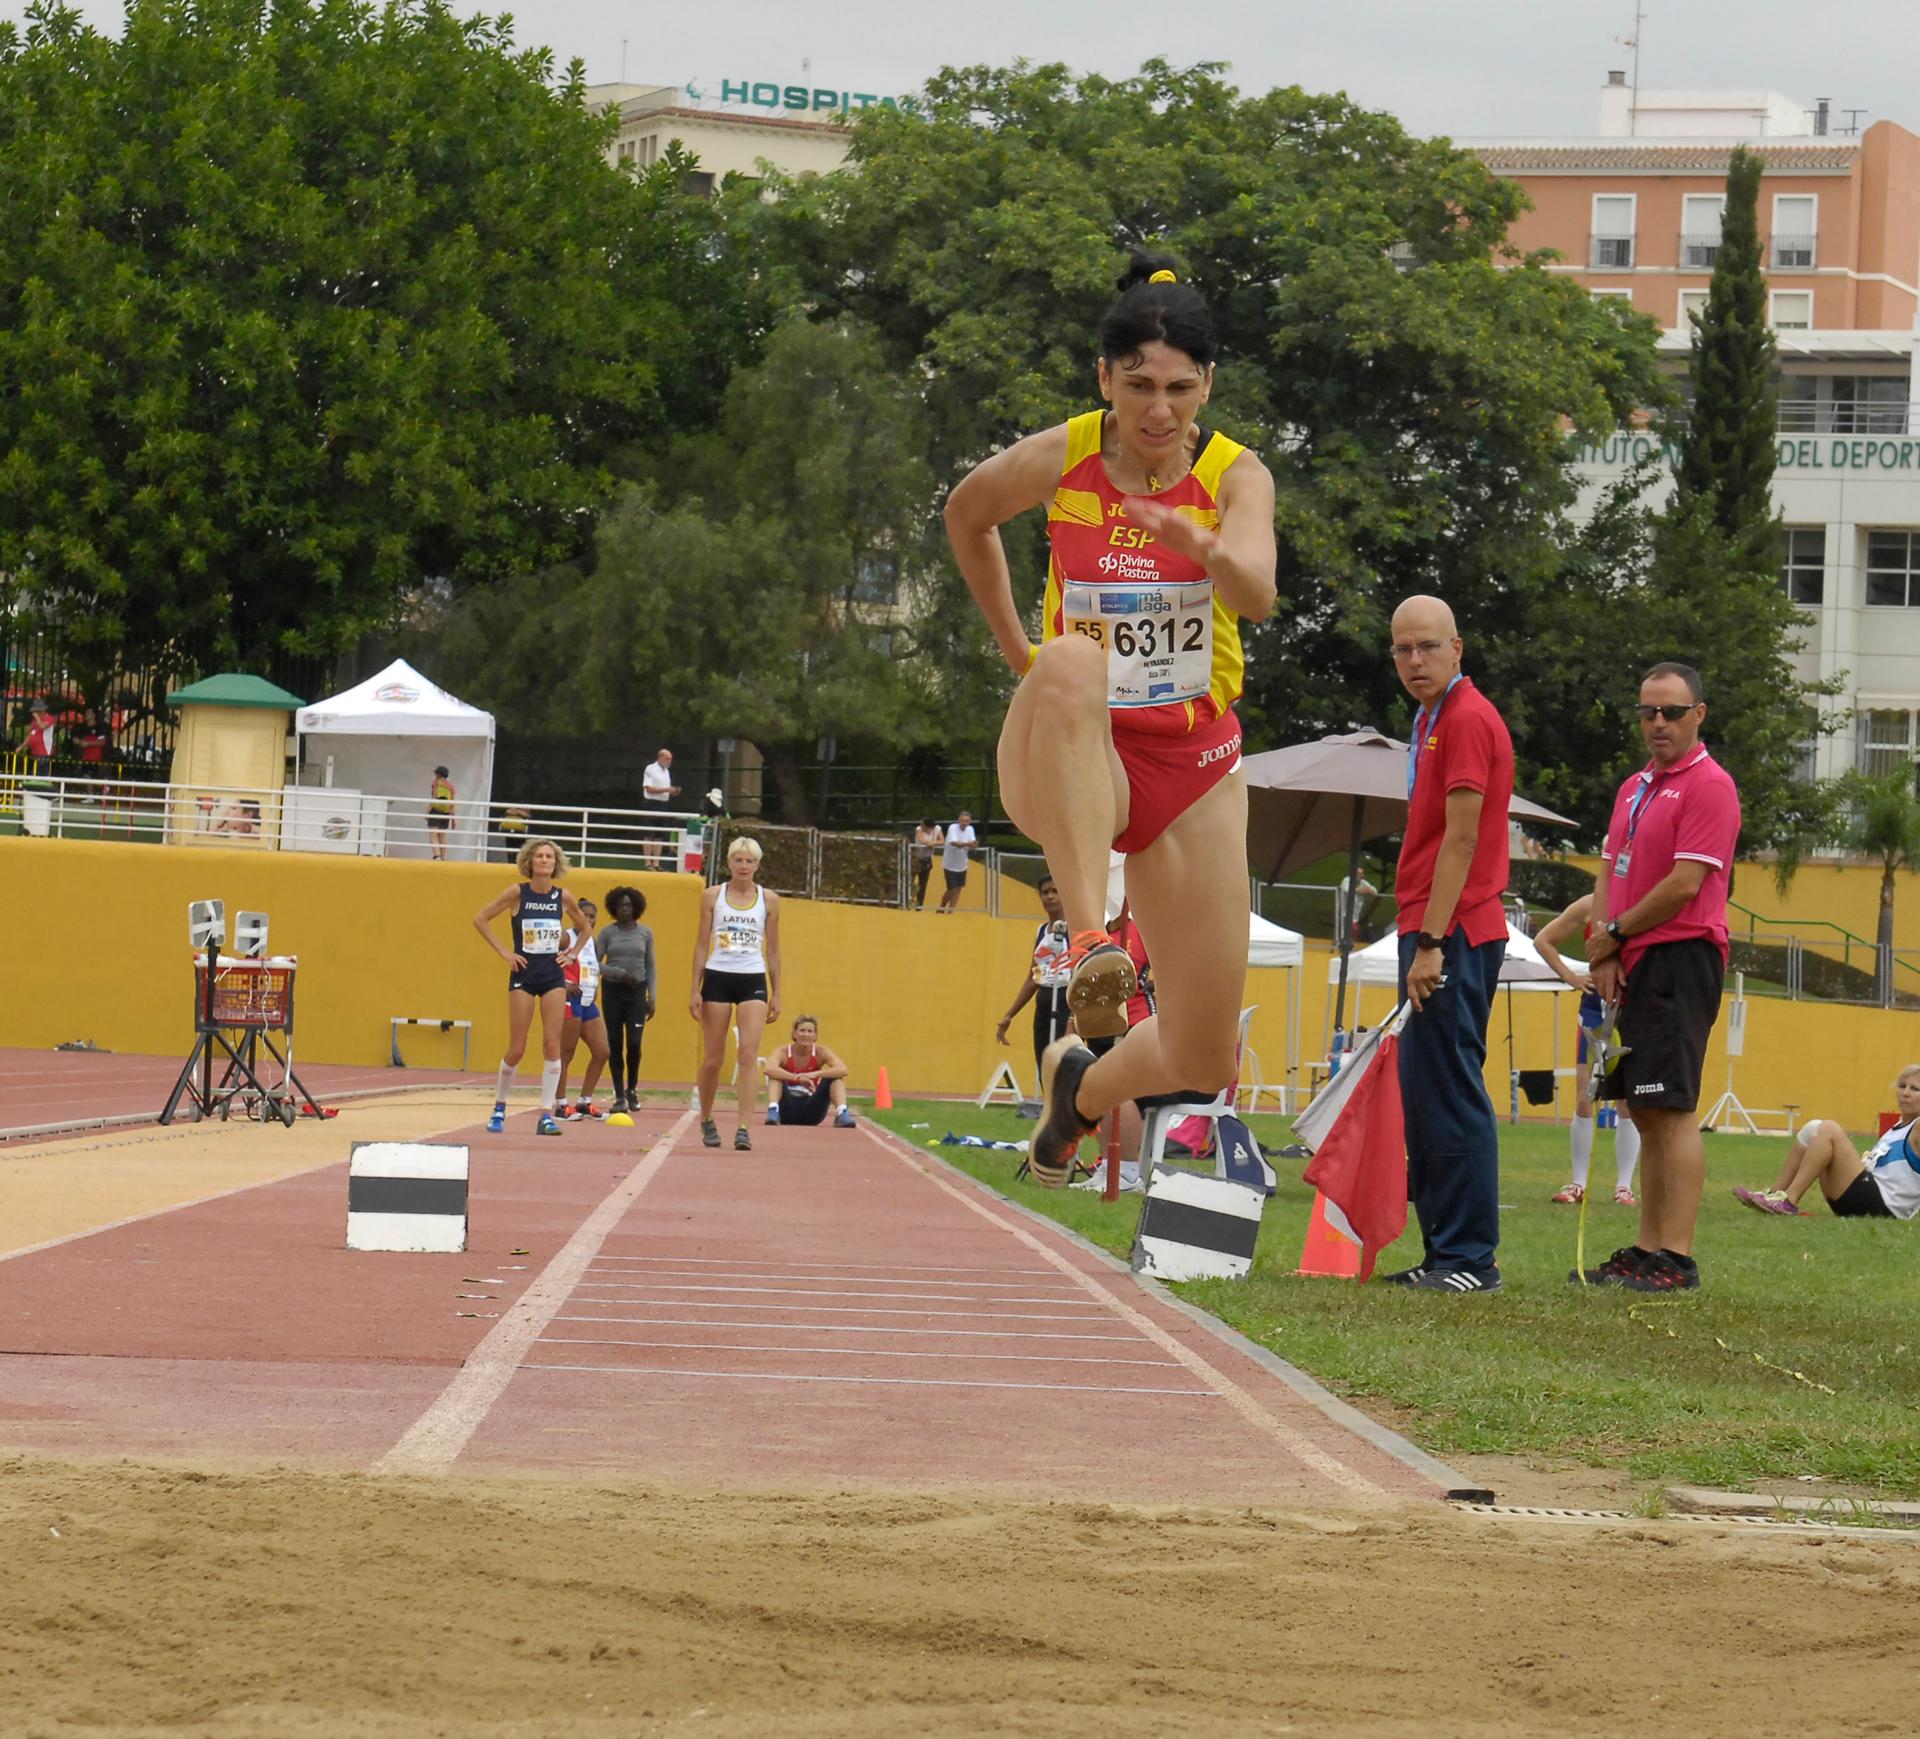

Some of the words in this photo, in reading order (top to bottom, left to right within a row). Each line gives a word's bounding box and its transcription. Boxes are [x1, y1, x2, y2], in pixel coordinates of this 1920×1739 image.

[1779, 440, 1823, 468] DEL
[1108, 525, 1156, 550] ESP
[1119, 553, 1155, 569] Divina
[1117, 566, 1160, 581] Pastora
[1114, 617, 1204, 657] 6312
[723, 915, 757, 924] LATVIA
[537, 929, 560, 940] 1795
